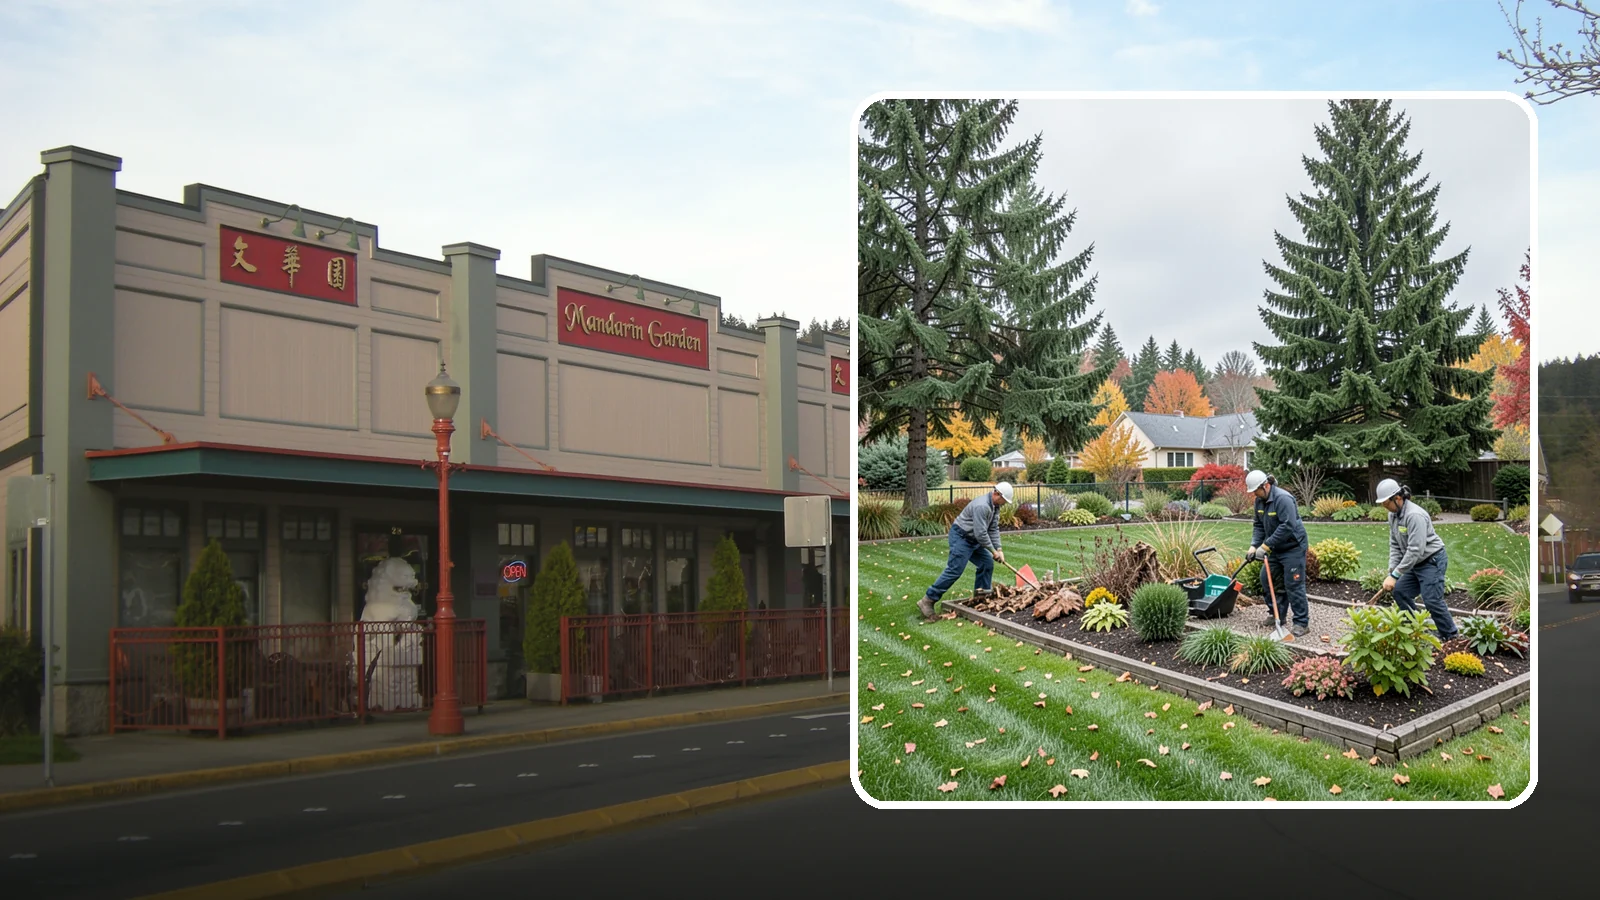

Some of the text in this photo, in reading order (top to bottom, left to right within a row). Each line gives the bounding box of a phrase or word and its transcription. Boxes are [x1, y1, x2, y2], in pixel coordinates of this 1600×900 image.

[230, 235, 346, 291] 文華園
[564, 302, 702, 352] Mandarin Garden
[503, 565, 527, 578] OPEN
